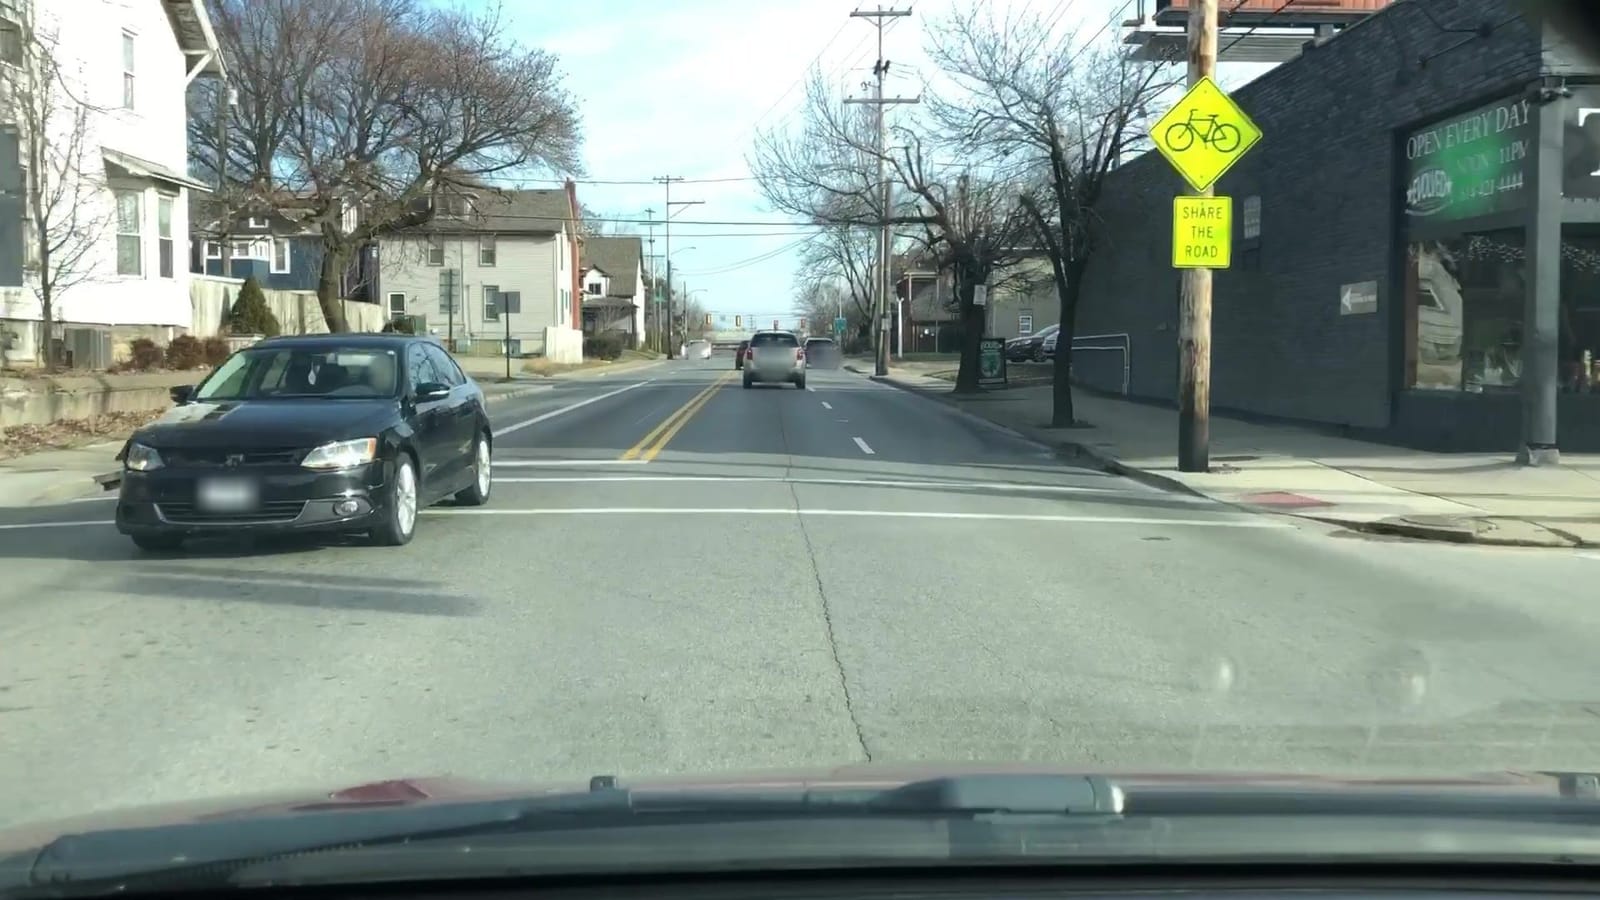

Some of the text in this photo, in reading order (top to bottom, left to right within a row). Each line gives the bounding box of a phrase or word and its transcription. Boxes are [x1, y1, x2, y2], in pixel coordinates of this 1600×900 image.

[1406, 99, 1530, 160] OPEN EVERY DAY
[1183, 206, 1223, 220] SHARE
[1191, 225, 1213, 239] THE
[1185, 245, 1218, 258] ROAD
